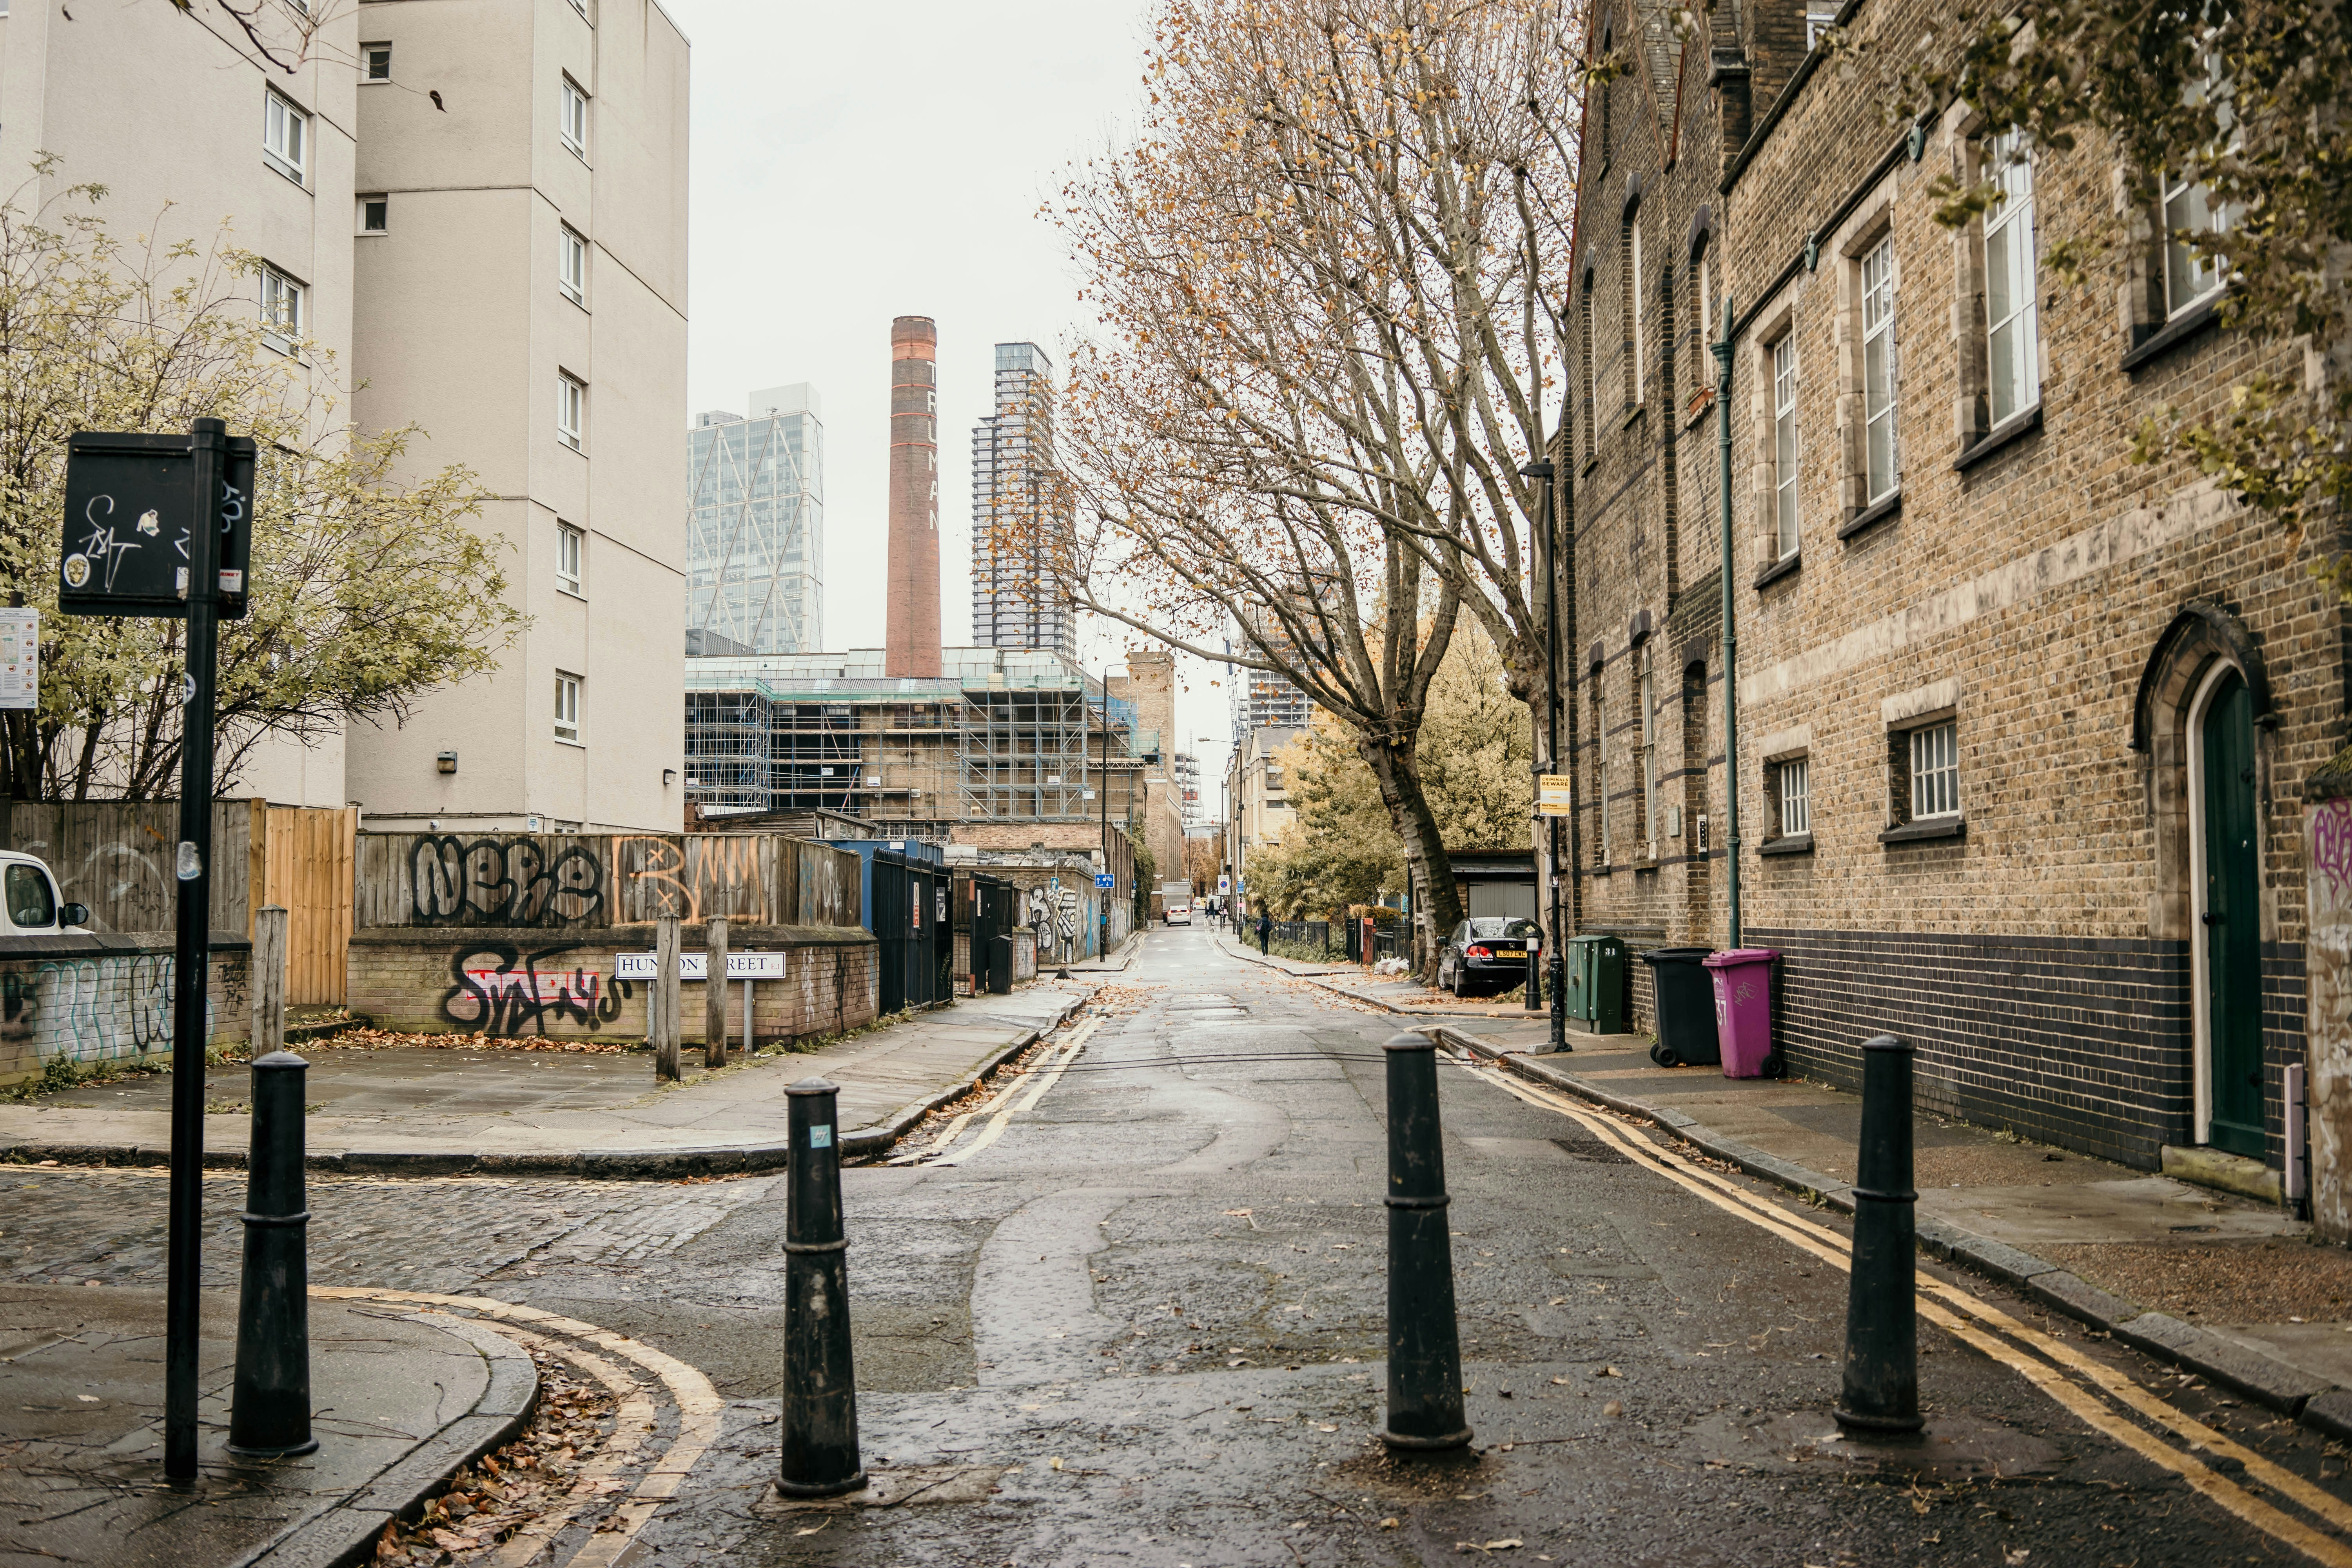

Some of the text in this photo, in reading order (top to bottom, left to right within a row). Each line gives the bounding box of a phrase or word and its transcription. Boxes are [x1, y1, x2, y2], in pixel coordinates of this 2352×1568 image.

[1605, 947, 1615, 956] 31
[621, 958, 698, 971] HUNN
[706, 958, 767, 970] REET
